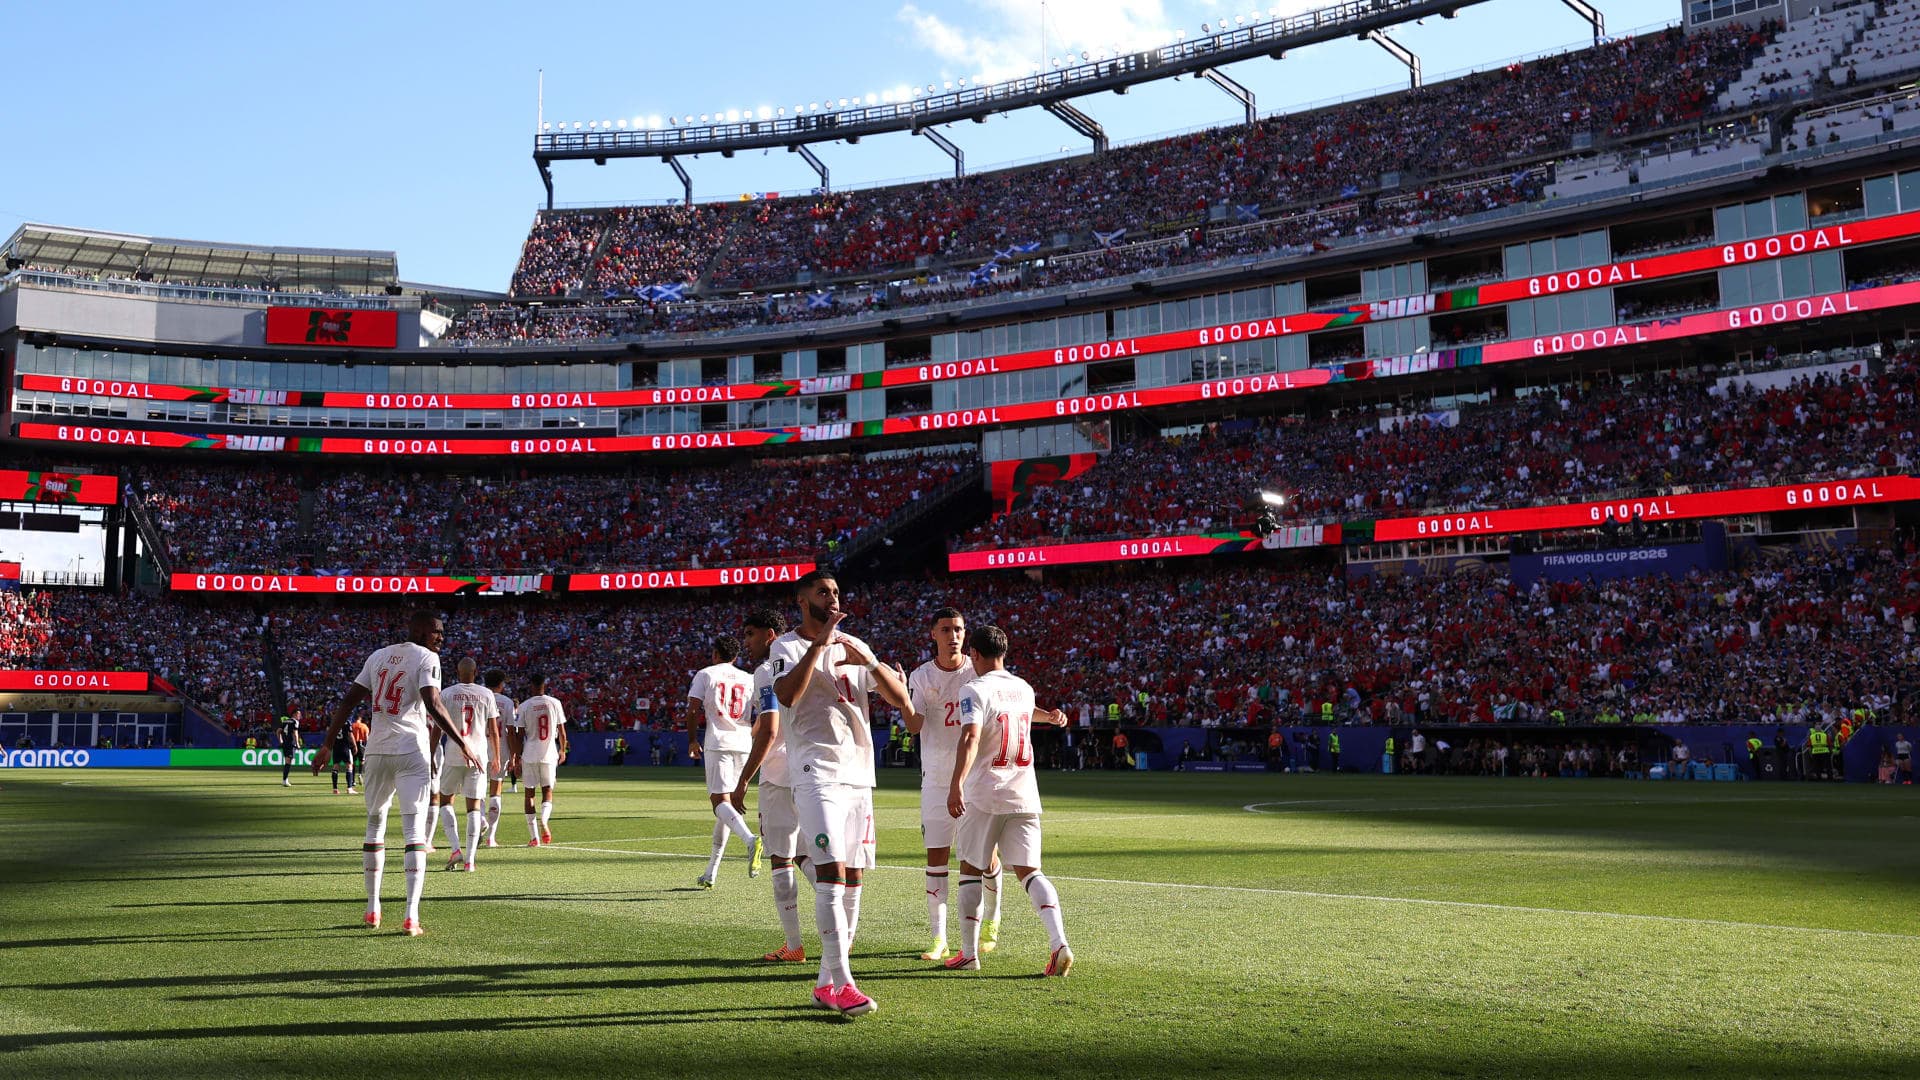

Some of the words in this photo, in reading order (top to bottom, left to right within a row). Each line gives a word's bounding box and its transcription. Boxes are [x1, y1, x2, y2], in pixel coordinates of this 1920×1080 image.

[1723, 226, 1852, 264] GOOOAL
[1529, 262, 1642, 295] GOOOAL
[1728, 293, 1859, 328] GOOOAL
[1199, 318, 1292, 345] GOOOAL
[1533, 326, 1648, 356] GOOOAL
[1054, 339, 1140, 364] GOOOAL
[919, 358, 1000, 381] GOOOAL
[60, 377, 154, 398] GOOOAL
[652, 386, 736, 404] GOOOAL
[1201, 372, 1295, 399] GOOOAL
[365, 394, 453, 408] GOOOAL
[511, 393, 597, 408] GOOOAL
[1056, 391, 1142, 416] GOOOAL
[920, 408, 1001, 430] GOOOAL
[58, 426, 151, 445] GOOOAL
[652, 433, 736, 450] GOOOAL
[364, 439, 452, 454] GOOOAL
[510, 438, 596, 453] GOOOAL
[1786, 483, 1883, 505] GOOOAL
[1590, 501, 1675, 520] GOOOAL
[1418, 516, 1494, 534] GOOOAL
[988, 550, 1046, 565] GOOOAL
[1120, 540, 1183, 556] GOOOAL
[1543, 555, 1566, 566] FIFA
[1566, 553, 1604, 564] WORLD
[1605, 551, 1628, 562] CUP
[1629, 548, 1668, 561] 2026
[196, 574, 298, 591] GOOOAL
[600, 571, 689, 589] GOOOAL
[719, 564, 802, 585] GOOOAL
[335, 577, 435, 593] GOOOAL
[34, 674, 110, 687] GOOOAL
[372, 668, 406, 716] 14
[538, 714, 549, 741] 8
[241, 749, 317, 766] aramc
